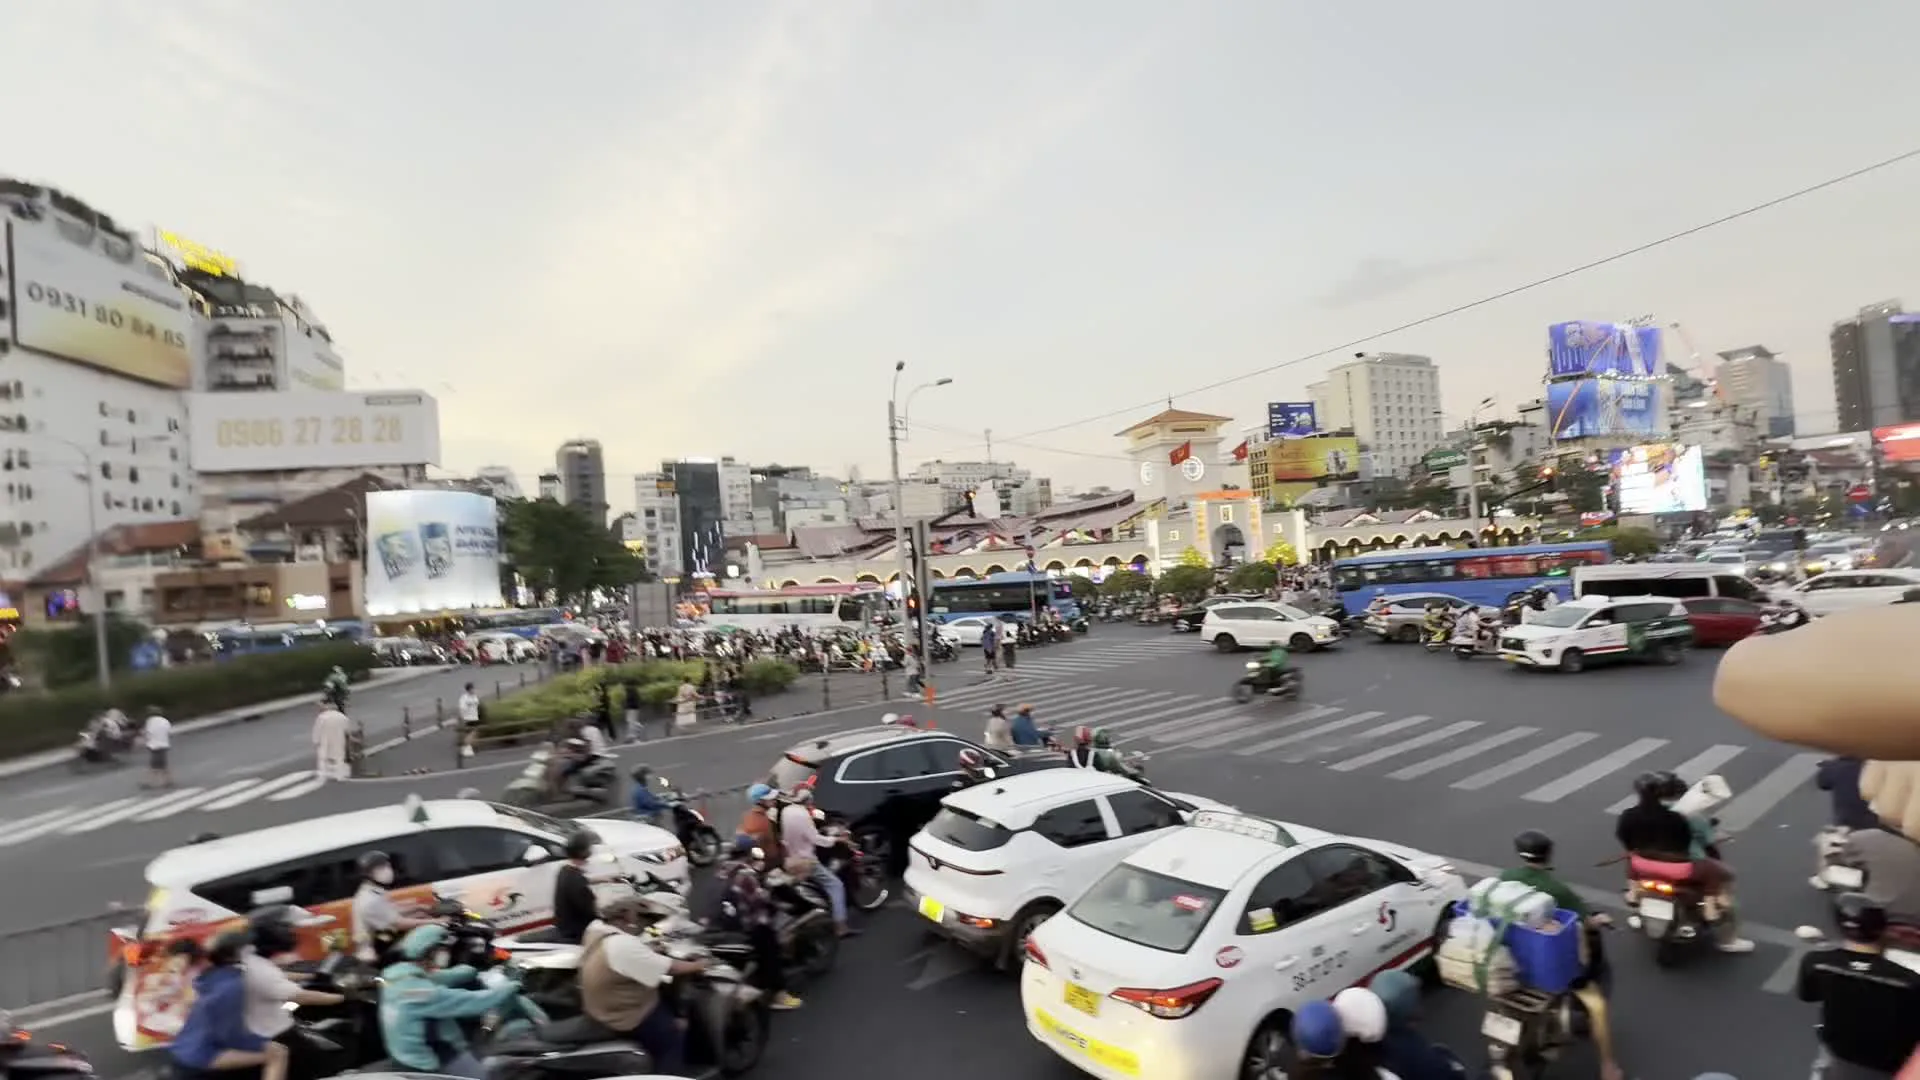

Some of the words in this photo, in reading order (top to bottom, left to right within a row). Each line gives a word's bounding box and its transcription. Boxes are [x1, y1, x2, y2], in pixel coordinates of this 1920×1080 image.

[27, 281, 87, 318] 0931
[293, 415, 323, 445] 27
[331, 414, 364, 444] 28
[373, 412, 404, 442] 28
